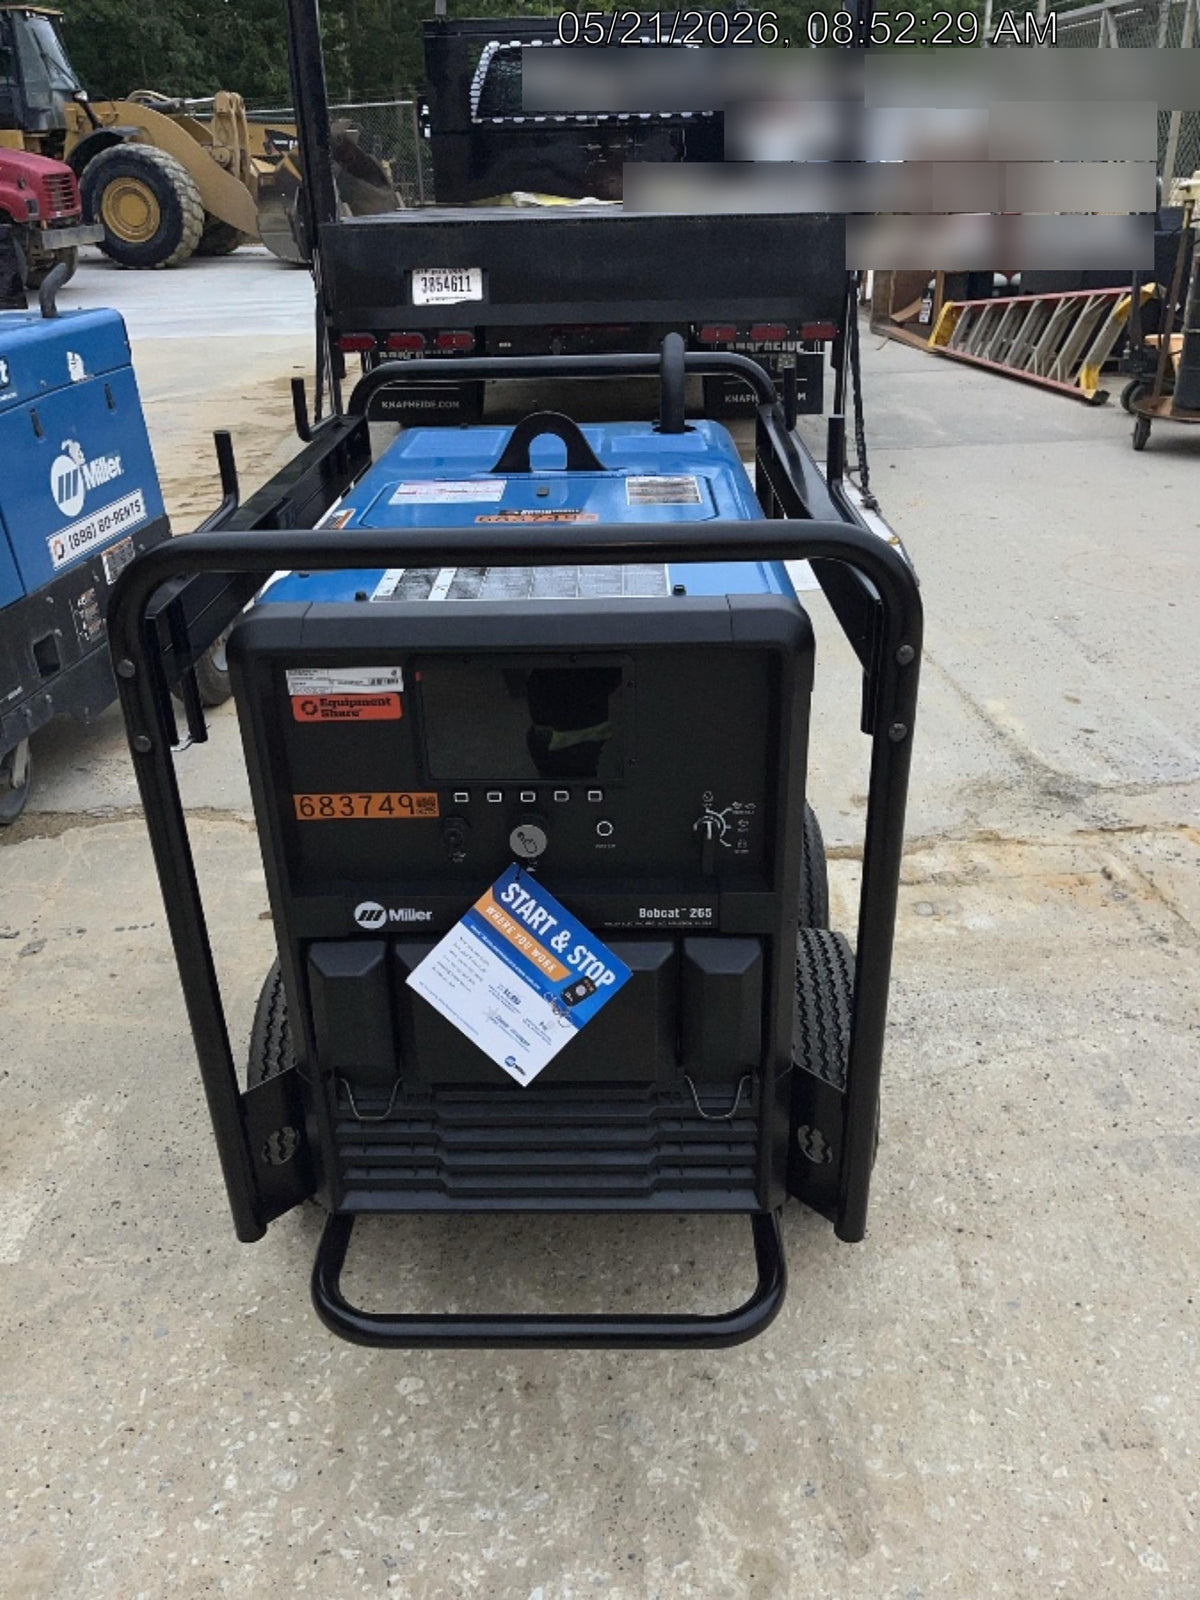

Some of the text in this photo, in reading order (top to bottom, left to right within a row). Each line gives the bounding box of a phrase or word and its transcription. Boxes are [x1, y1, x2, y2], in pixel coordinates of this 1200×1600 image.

[421, 275, 472, 293] 3854611
[81, 455, 122, 490] Miller
[320, 697, 392, 708] Equipment
[321, 708, 360, 718] Share
[300, 794, 415, 817] 683749
[388, 908, 432, 921] Miller
[690, 908, 712, 918] 265
[485, 906, 557, 973] WHERE YOU WORK
[500, 882, 558, 936] START
[551, 929, 571, 953] &
[567, 945, 616, 987] STOP
